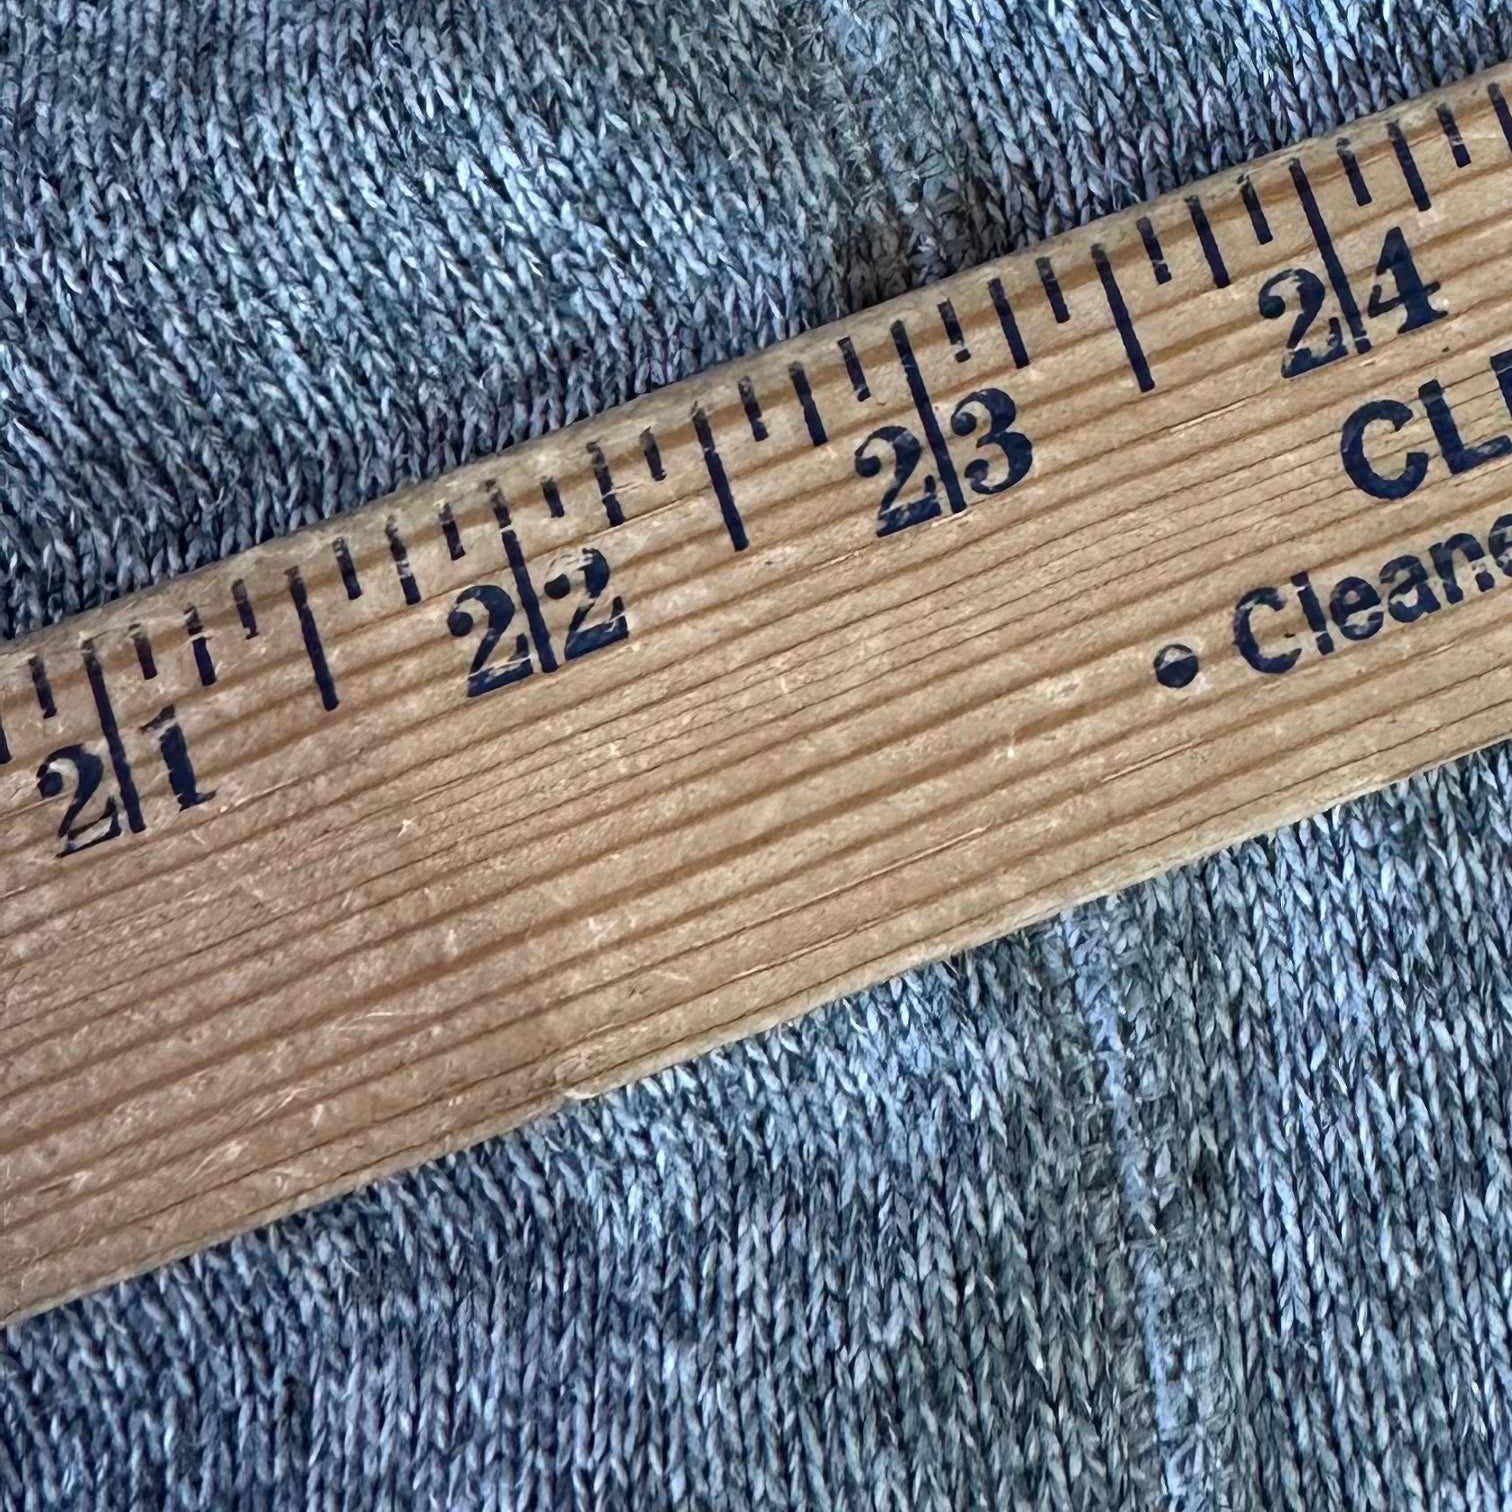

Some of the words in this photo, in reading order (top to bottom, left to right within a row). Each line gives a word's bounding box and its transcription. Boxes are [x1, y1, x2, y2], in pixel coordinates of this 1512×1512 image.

[34, 705, 216, 858] 21
[446, 548, 631, 697] 22
[853, 386, 1034, 537] 23
[1259, 228, 1448, 378] 24
